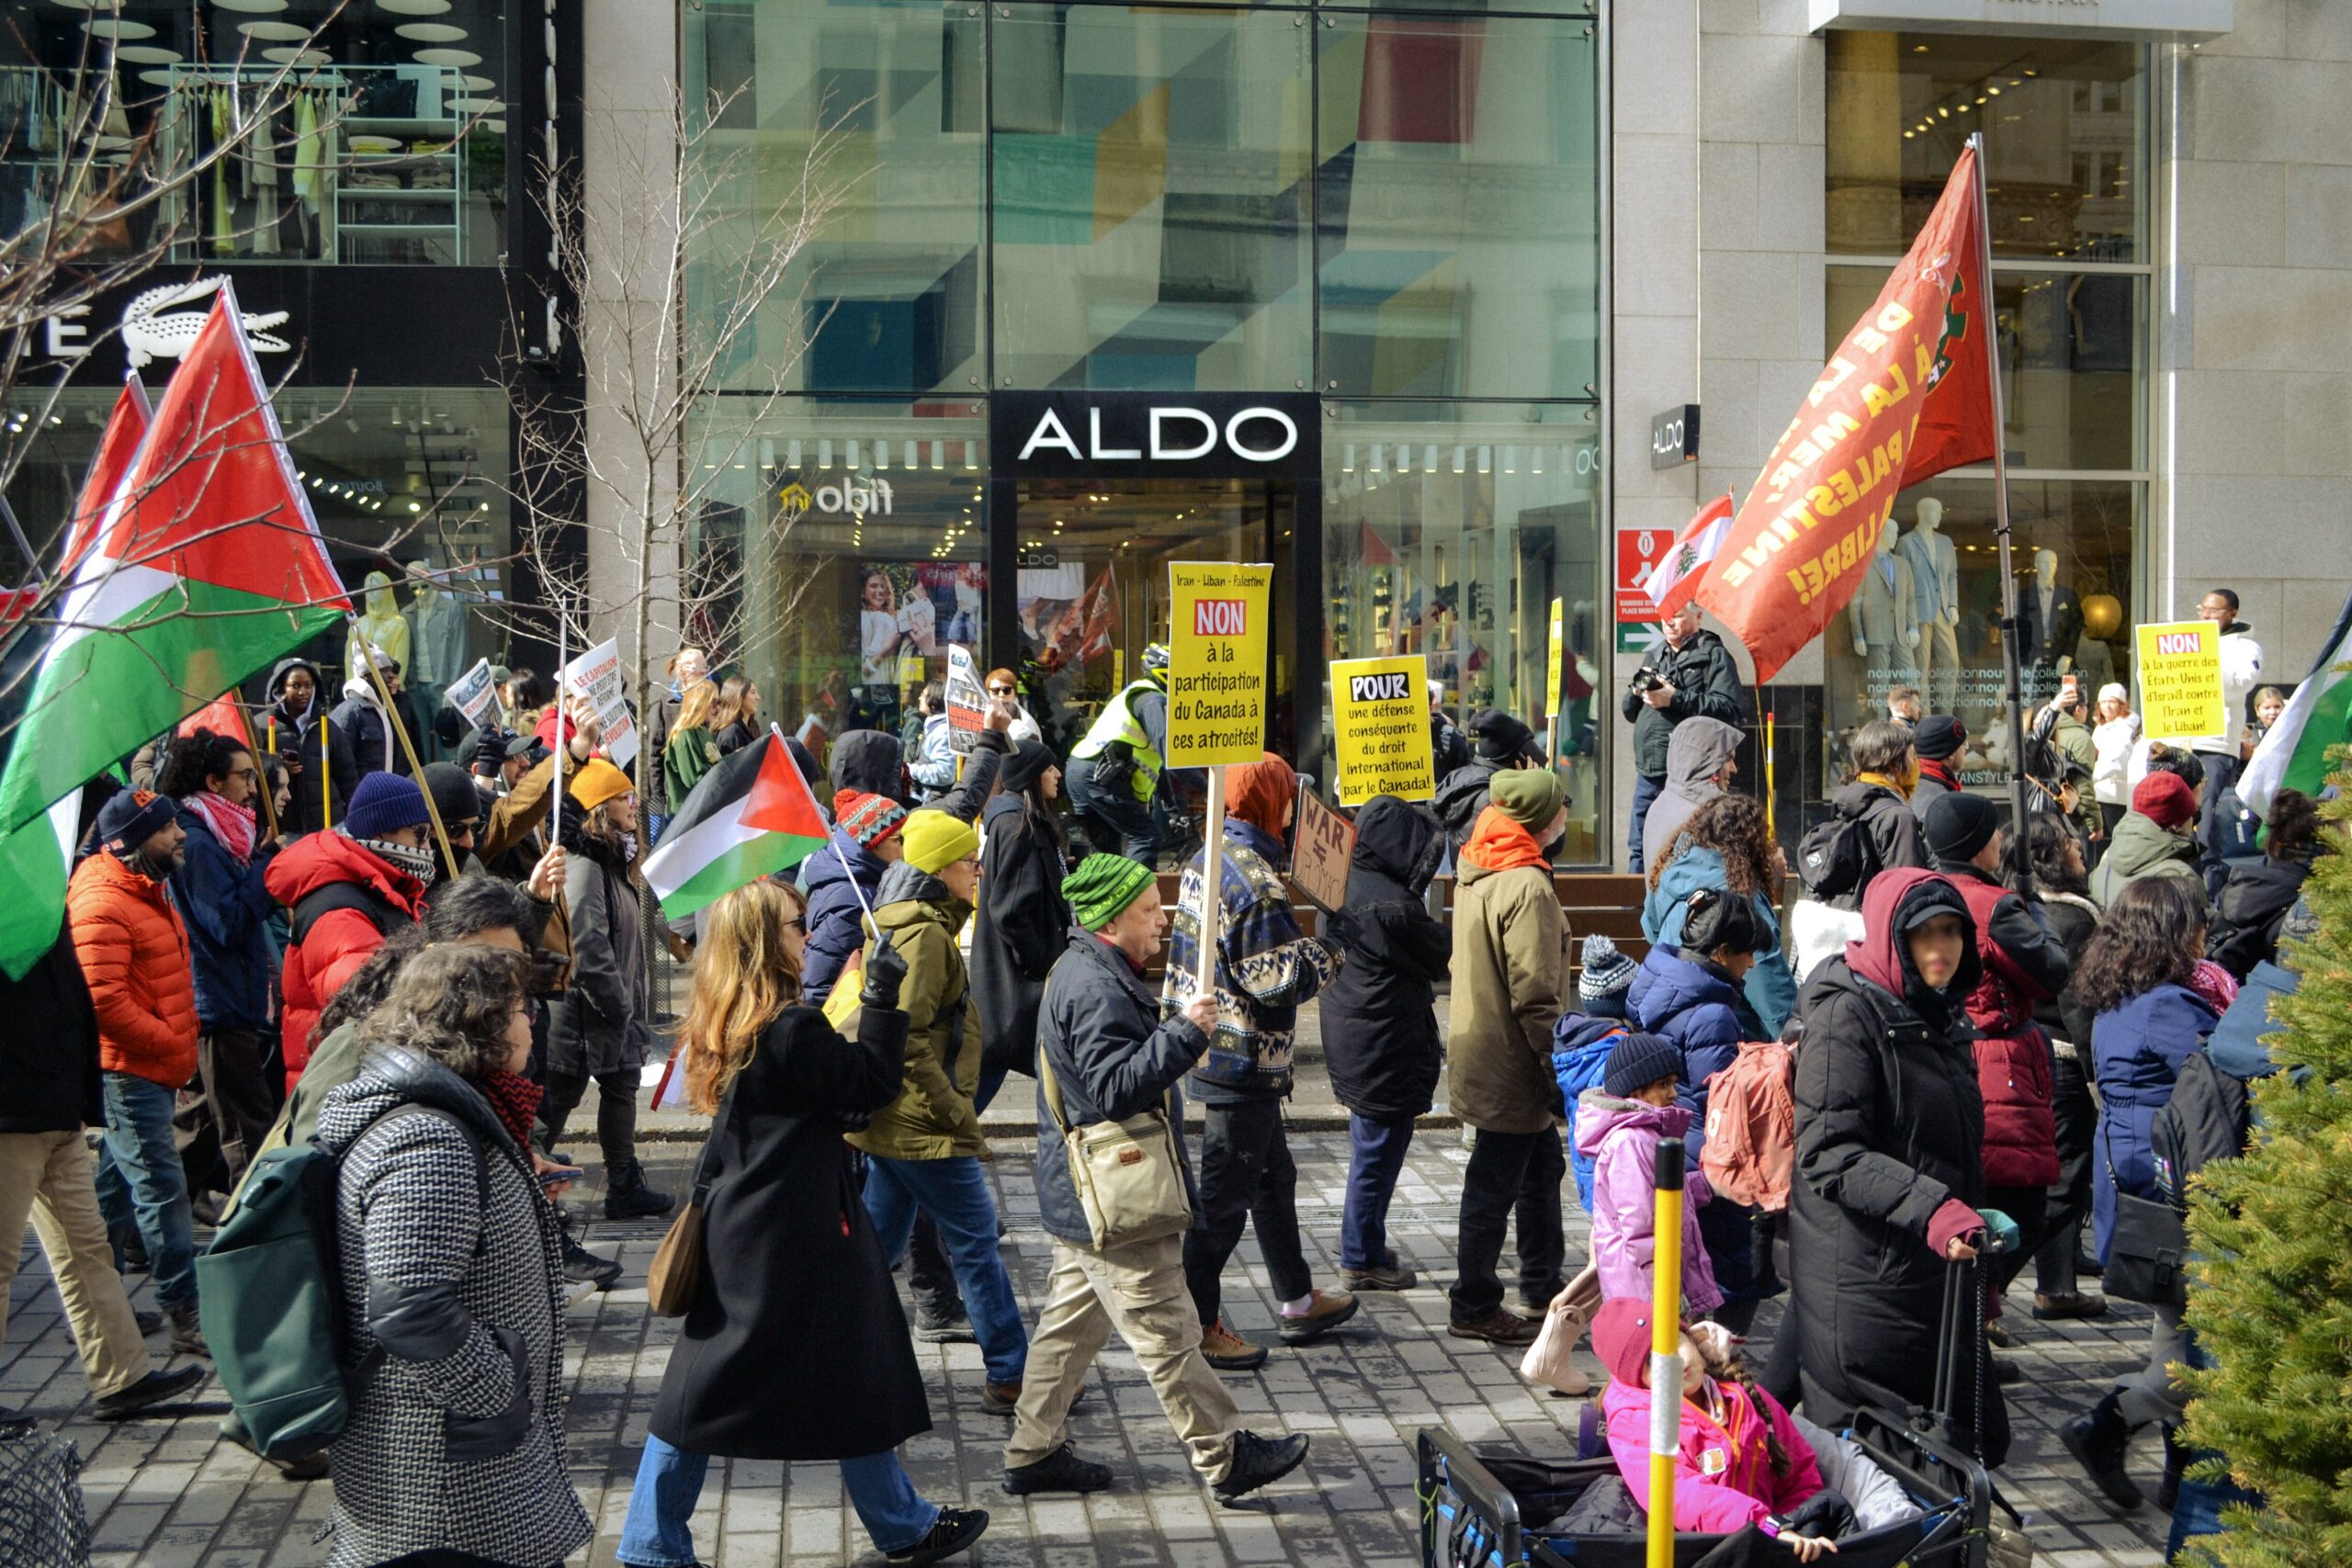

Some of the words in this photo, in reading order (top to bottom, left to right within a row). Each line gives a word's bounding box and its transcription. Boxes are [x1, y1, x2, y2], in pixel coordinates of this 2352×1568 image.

[1017, 407, 1298, 462] ALDO
[1653, 419, 1684, 456] ALDO
[1177, 574, 1194, 587] Iran
[1203, 574, 1226, 587] Liban
[1233, 574, 1265, 587] Palestine
[1197, 601, 1244, 635] NON
[1207, 642, 1216, 662] à
[1222, 642, 1234, 662] la
[2158, 633, 2199, 654] NON
[2143, 660, 2150, 671] à
[2154, 660, 2163, 670] la
[2166, 659, 2199, 671] guerre
[2201, 657, 2218, 667] des
[1175, 671, 1260, 695] participation
[1351, 674, 1408, 701] POUR
[2147, 671, 2202, 686] États-Unis
[2205, 673, 2215, 682] et
[2146, 689, 2183, 702] d'Israël
[2186, 690, 2219, 699] contre
[1175, 702, 1191, 720] du
[1195, 699, 1246, 720] Canada
[1250, 699, 1258, 717] à
[1349, 708, 1368, 719] une
[1372, 705, 1415, 718] défense
[2194, 705, 2203, 716] et
[1349, 723, 1418, 738] conséquente
[2164, 722, 2172, 733] le
[2175, 720, 2206, 732] Liban!
[1173, 735, 1193, 749] ces
[1198, 726, 1258, 749] atrocités!
[1363, 743, 1375, 755] du
[1379, 740, 1407, 753] droit
[1347, 757, 1424, 775] international
[1343, 785, 1364, 798] par
[1366, 781, 1376, 795] le
[1379, 775, 1430, 794] Canada!
[1306, 794, 1345, 856] WAR
[1085, 866, 1146, 920] SPYDER
